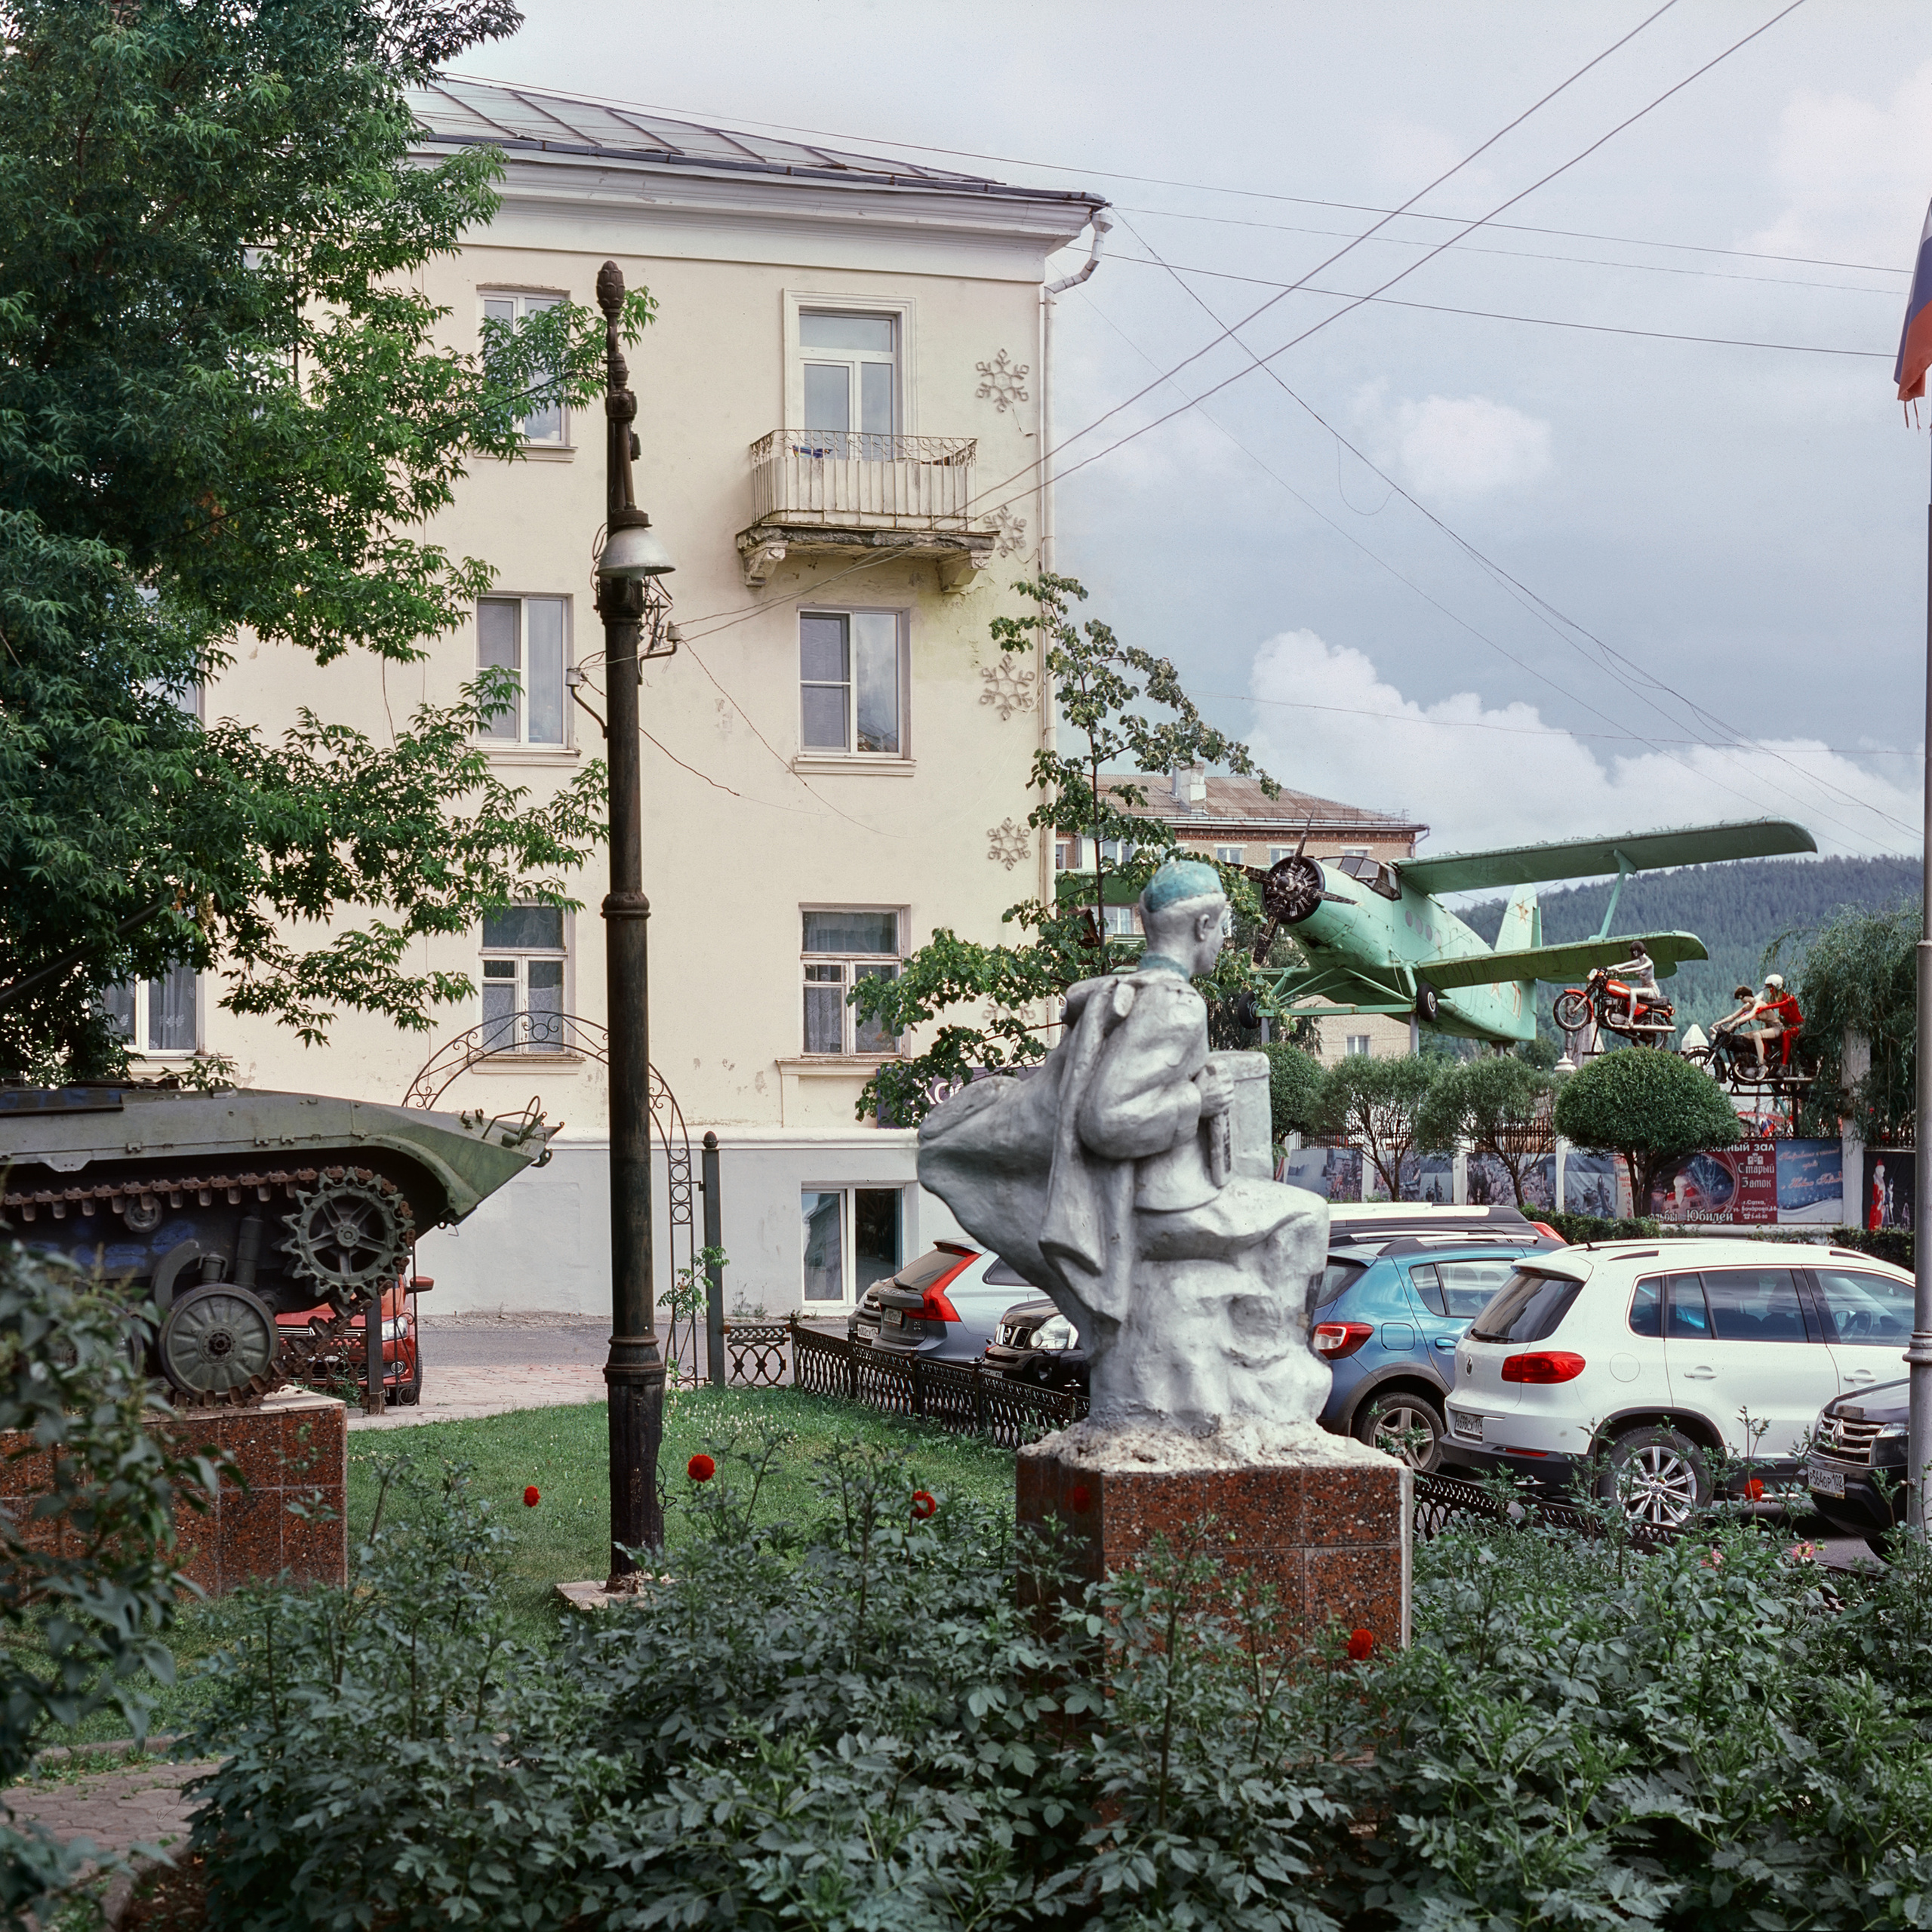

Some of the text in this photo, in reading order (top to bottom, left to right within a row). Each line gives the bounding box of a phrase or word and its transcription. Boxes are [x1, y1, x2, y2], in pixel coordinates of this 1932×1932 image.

[1753, 1143, 1775, 1152] зал
[1737, 1163, 1775, 1175] Старый
[1741, 1177, 1772, 1188] Замок
